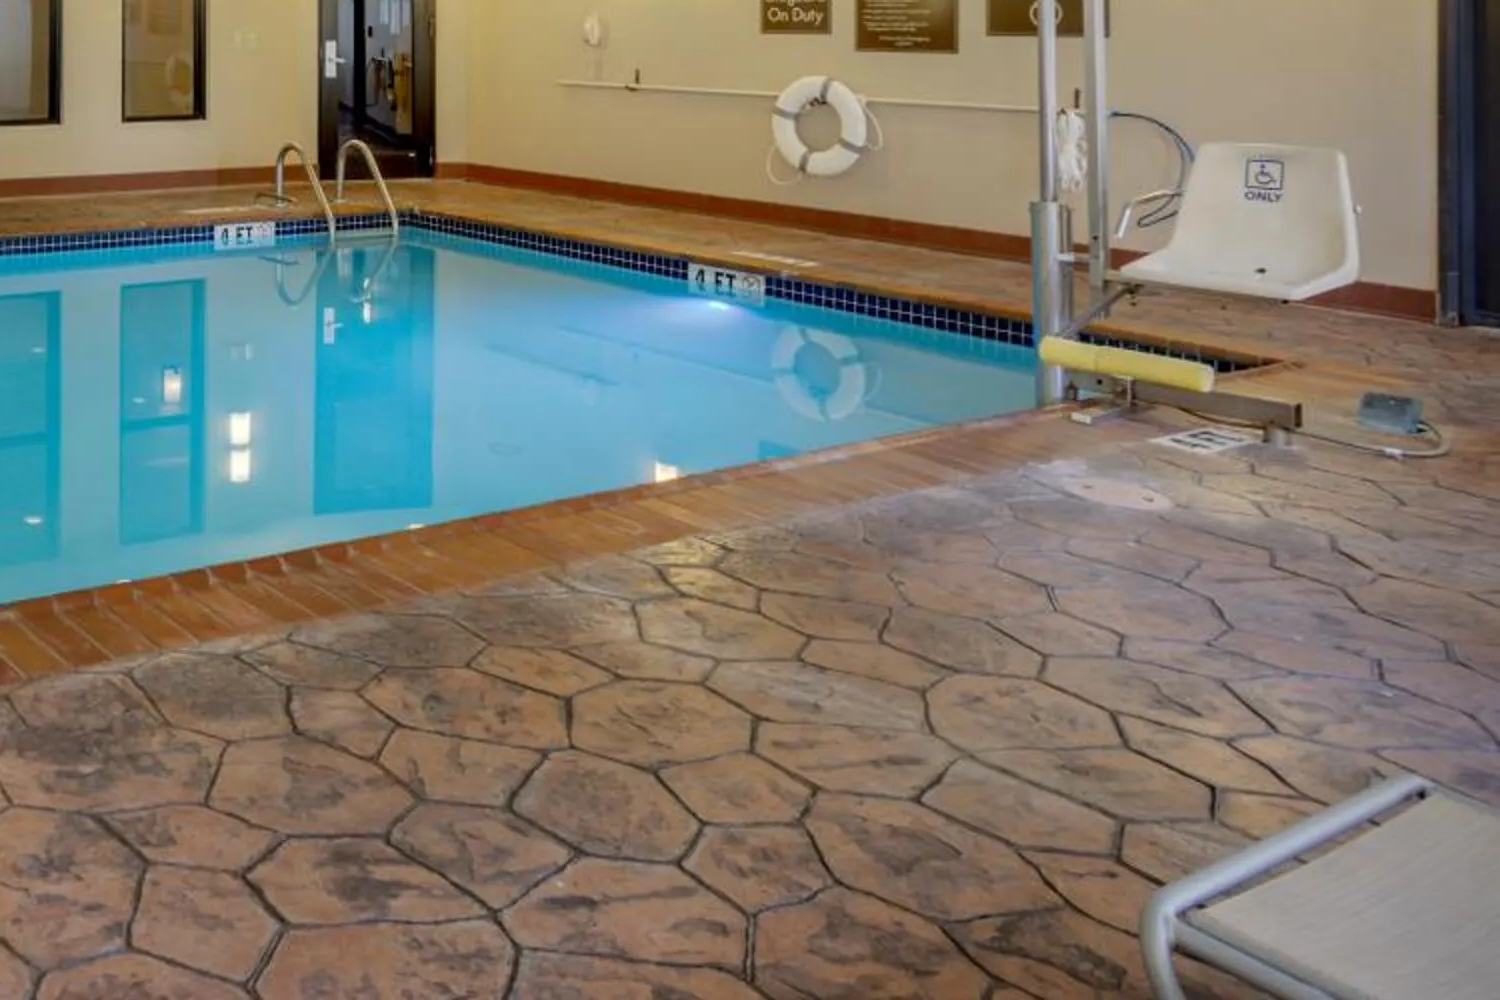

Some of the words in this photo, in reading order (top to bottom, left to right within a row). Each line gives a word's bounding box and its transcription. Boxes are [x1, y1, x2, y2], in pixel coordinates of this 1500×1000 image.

[767, 7, 789, 22] On
[791, 7, 824, 26] Duty
[1243, 191, 1283, 203] ONLY
